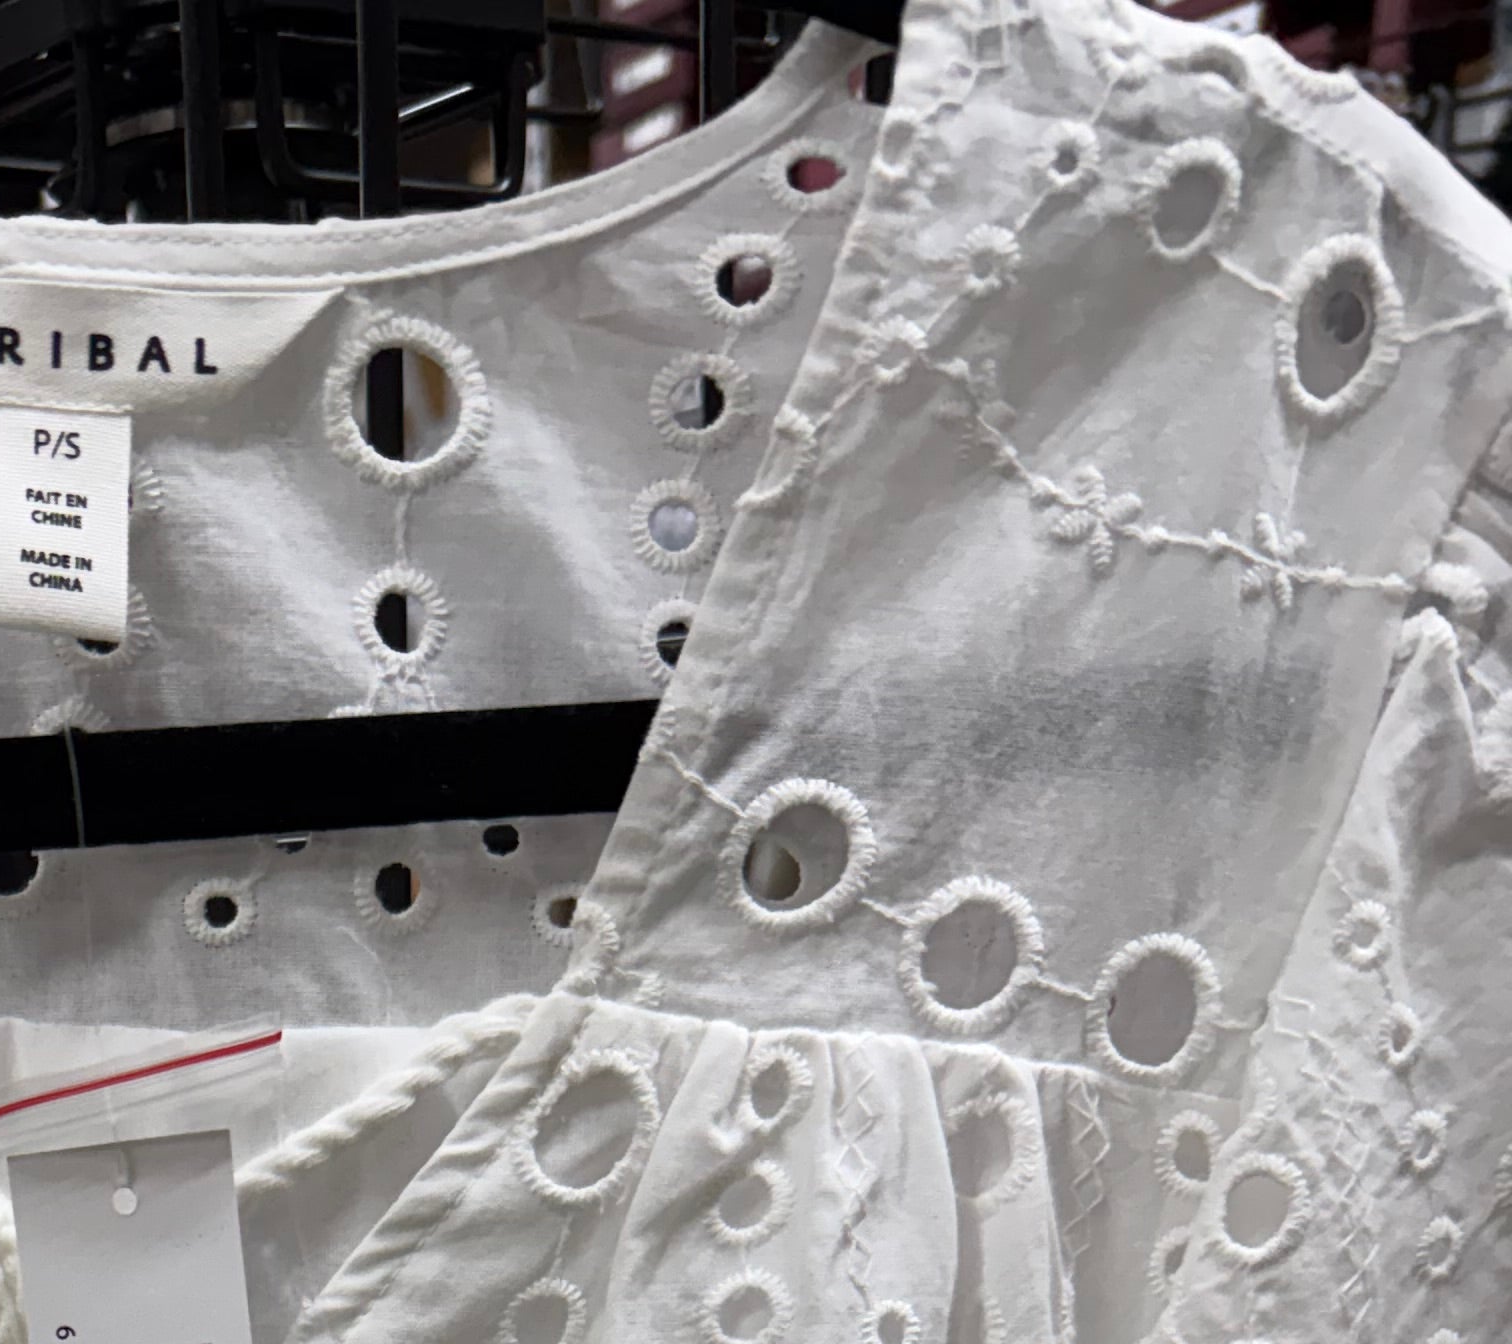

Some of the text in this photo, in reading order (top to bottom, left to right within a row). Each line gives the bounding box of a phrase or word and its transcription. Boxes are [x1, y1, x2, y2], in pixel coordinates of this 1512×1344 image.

[33, 428, 82, 460] P/S
[25, 488, 88, 509] FAIT EN
[31, 509, 83, 529] CHINE
[20, 548, 93, 572] MADE IN
[28, 571, 84, 593] CHINA
